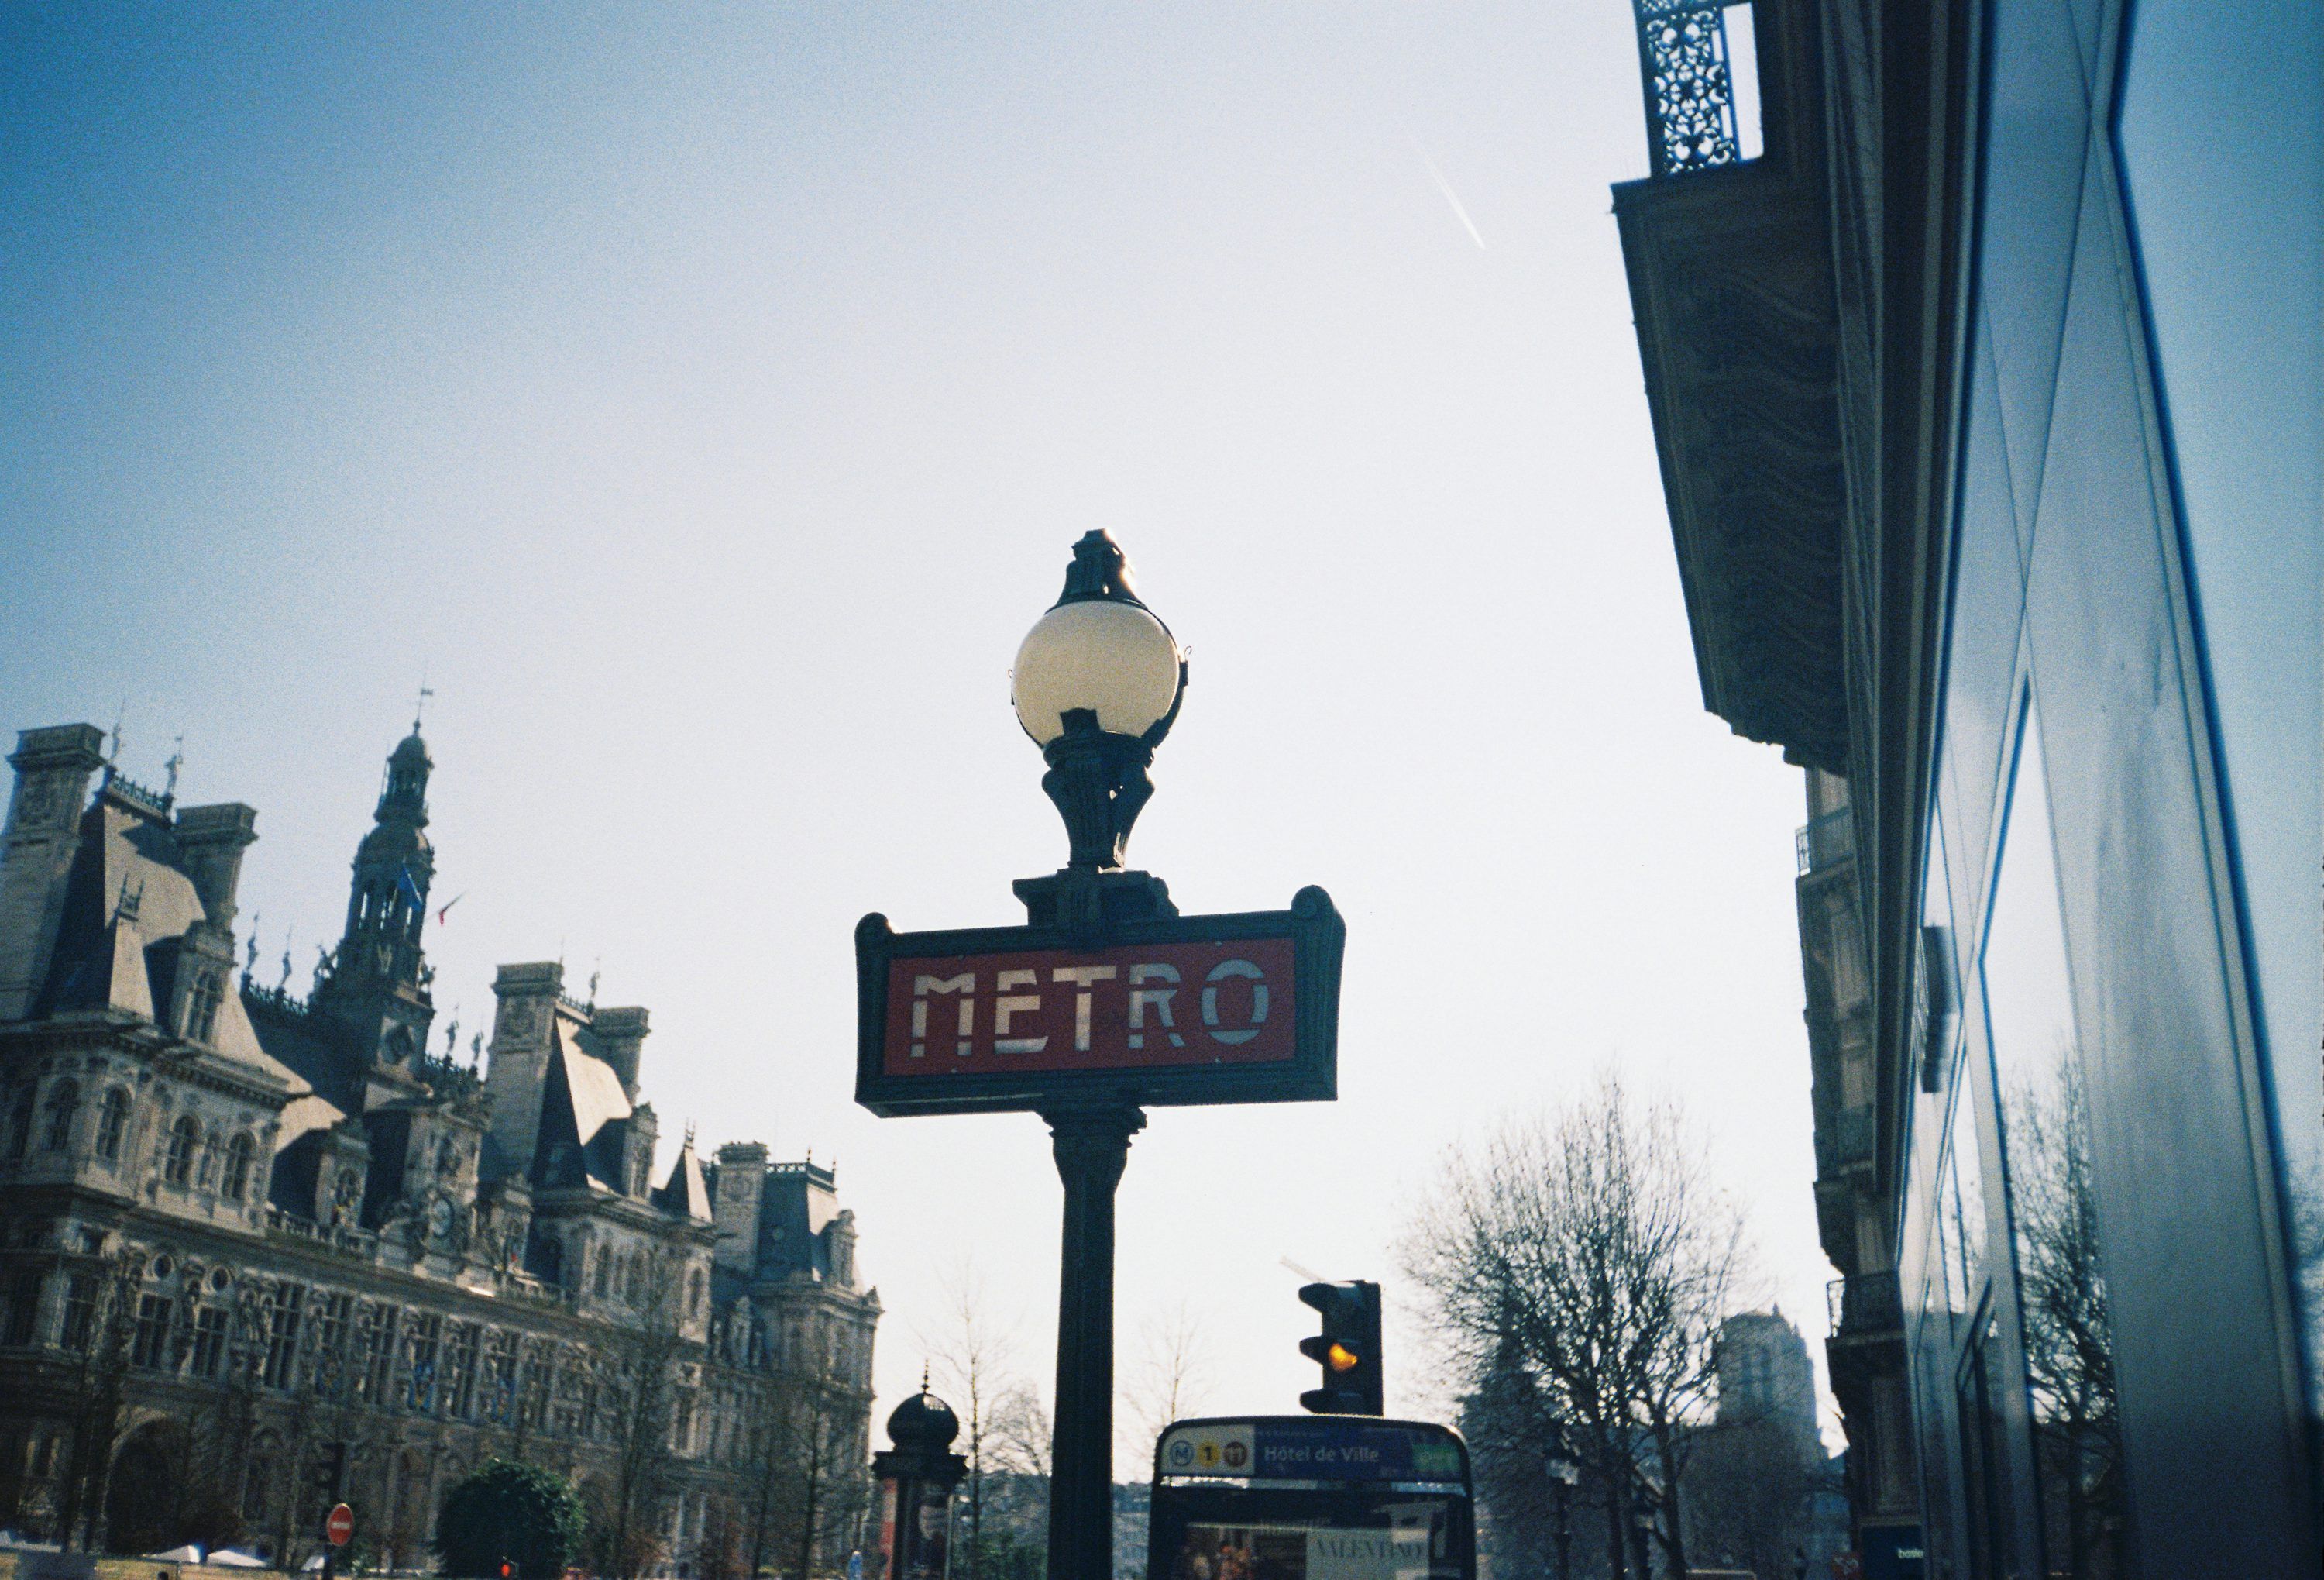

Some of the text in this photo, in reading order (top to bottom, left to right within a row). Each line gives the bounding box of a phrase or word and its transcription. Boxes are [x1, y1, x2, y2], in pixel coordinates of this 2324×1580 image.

[909, 958, 1270, 1058] METRO
[1202, 1445, 1213, 1461] 1
[1263, 1444, 1380, 1464] Hôtel de Ville
